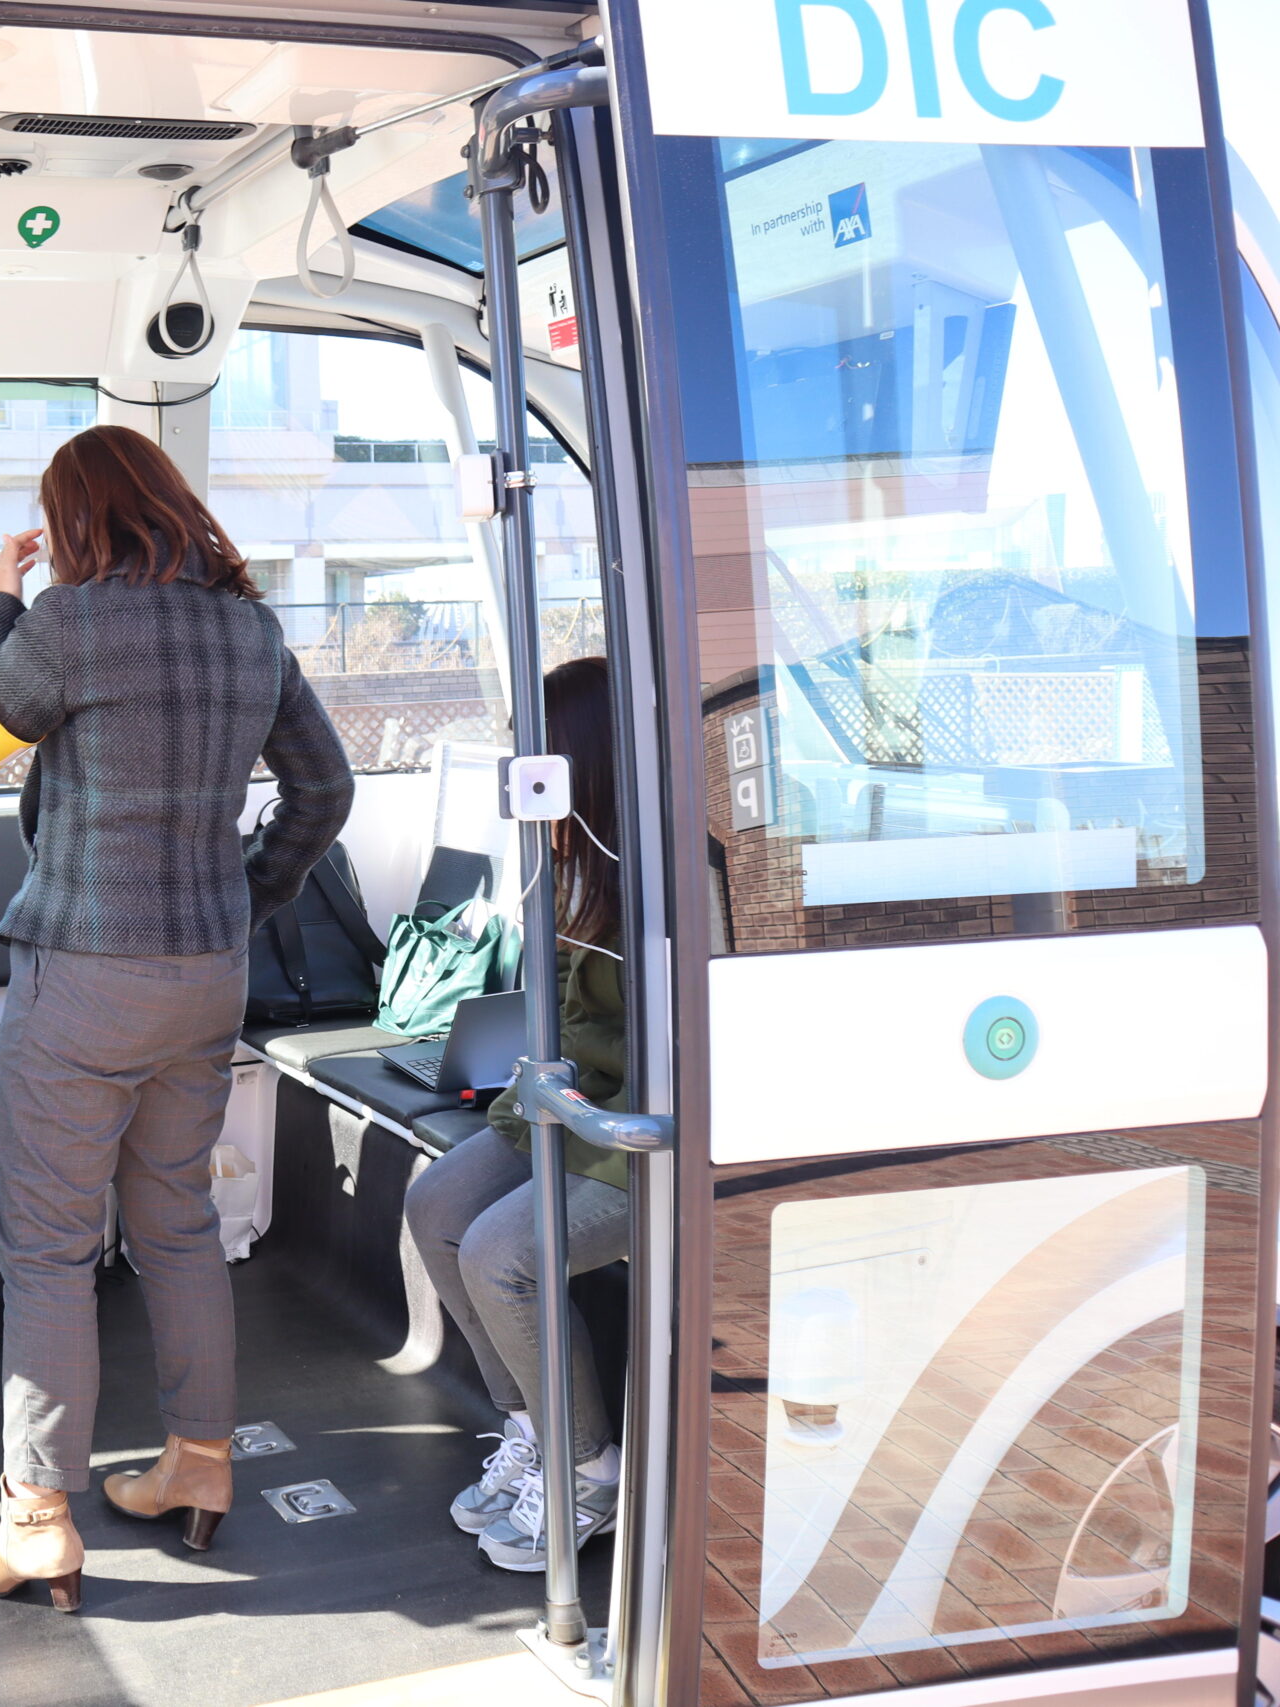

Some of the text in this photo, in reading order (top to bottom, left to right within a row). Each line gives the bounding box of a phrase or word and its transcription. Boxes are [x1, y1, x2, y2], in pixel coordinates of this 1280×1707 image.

[774, 0, 1066, 122] DIC
[751, 201, 823, 236] In partnership
[801, 218, 825, 236] with
[832, 214, 866, 243] AXA
